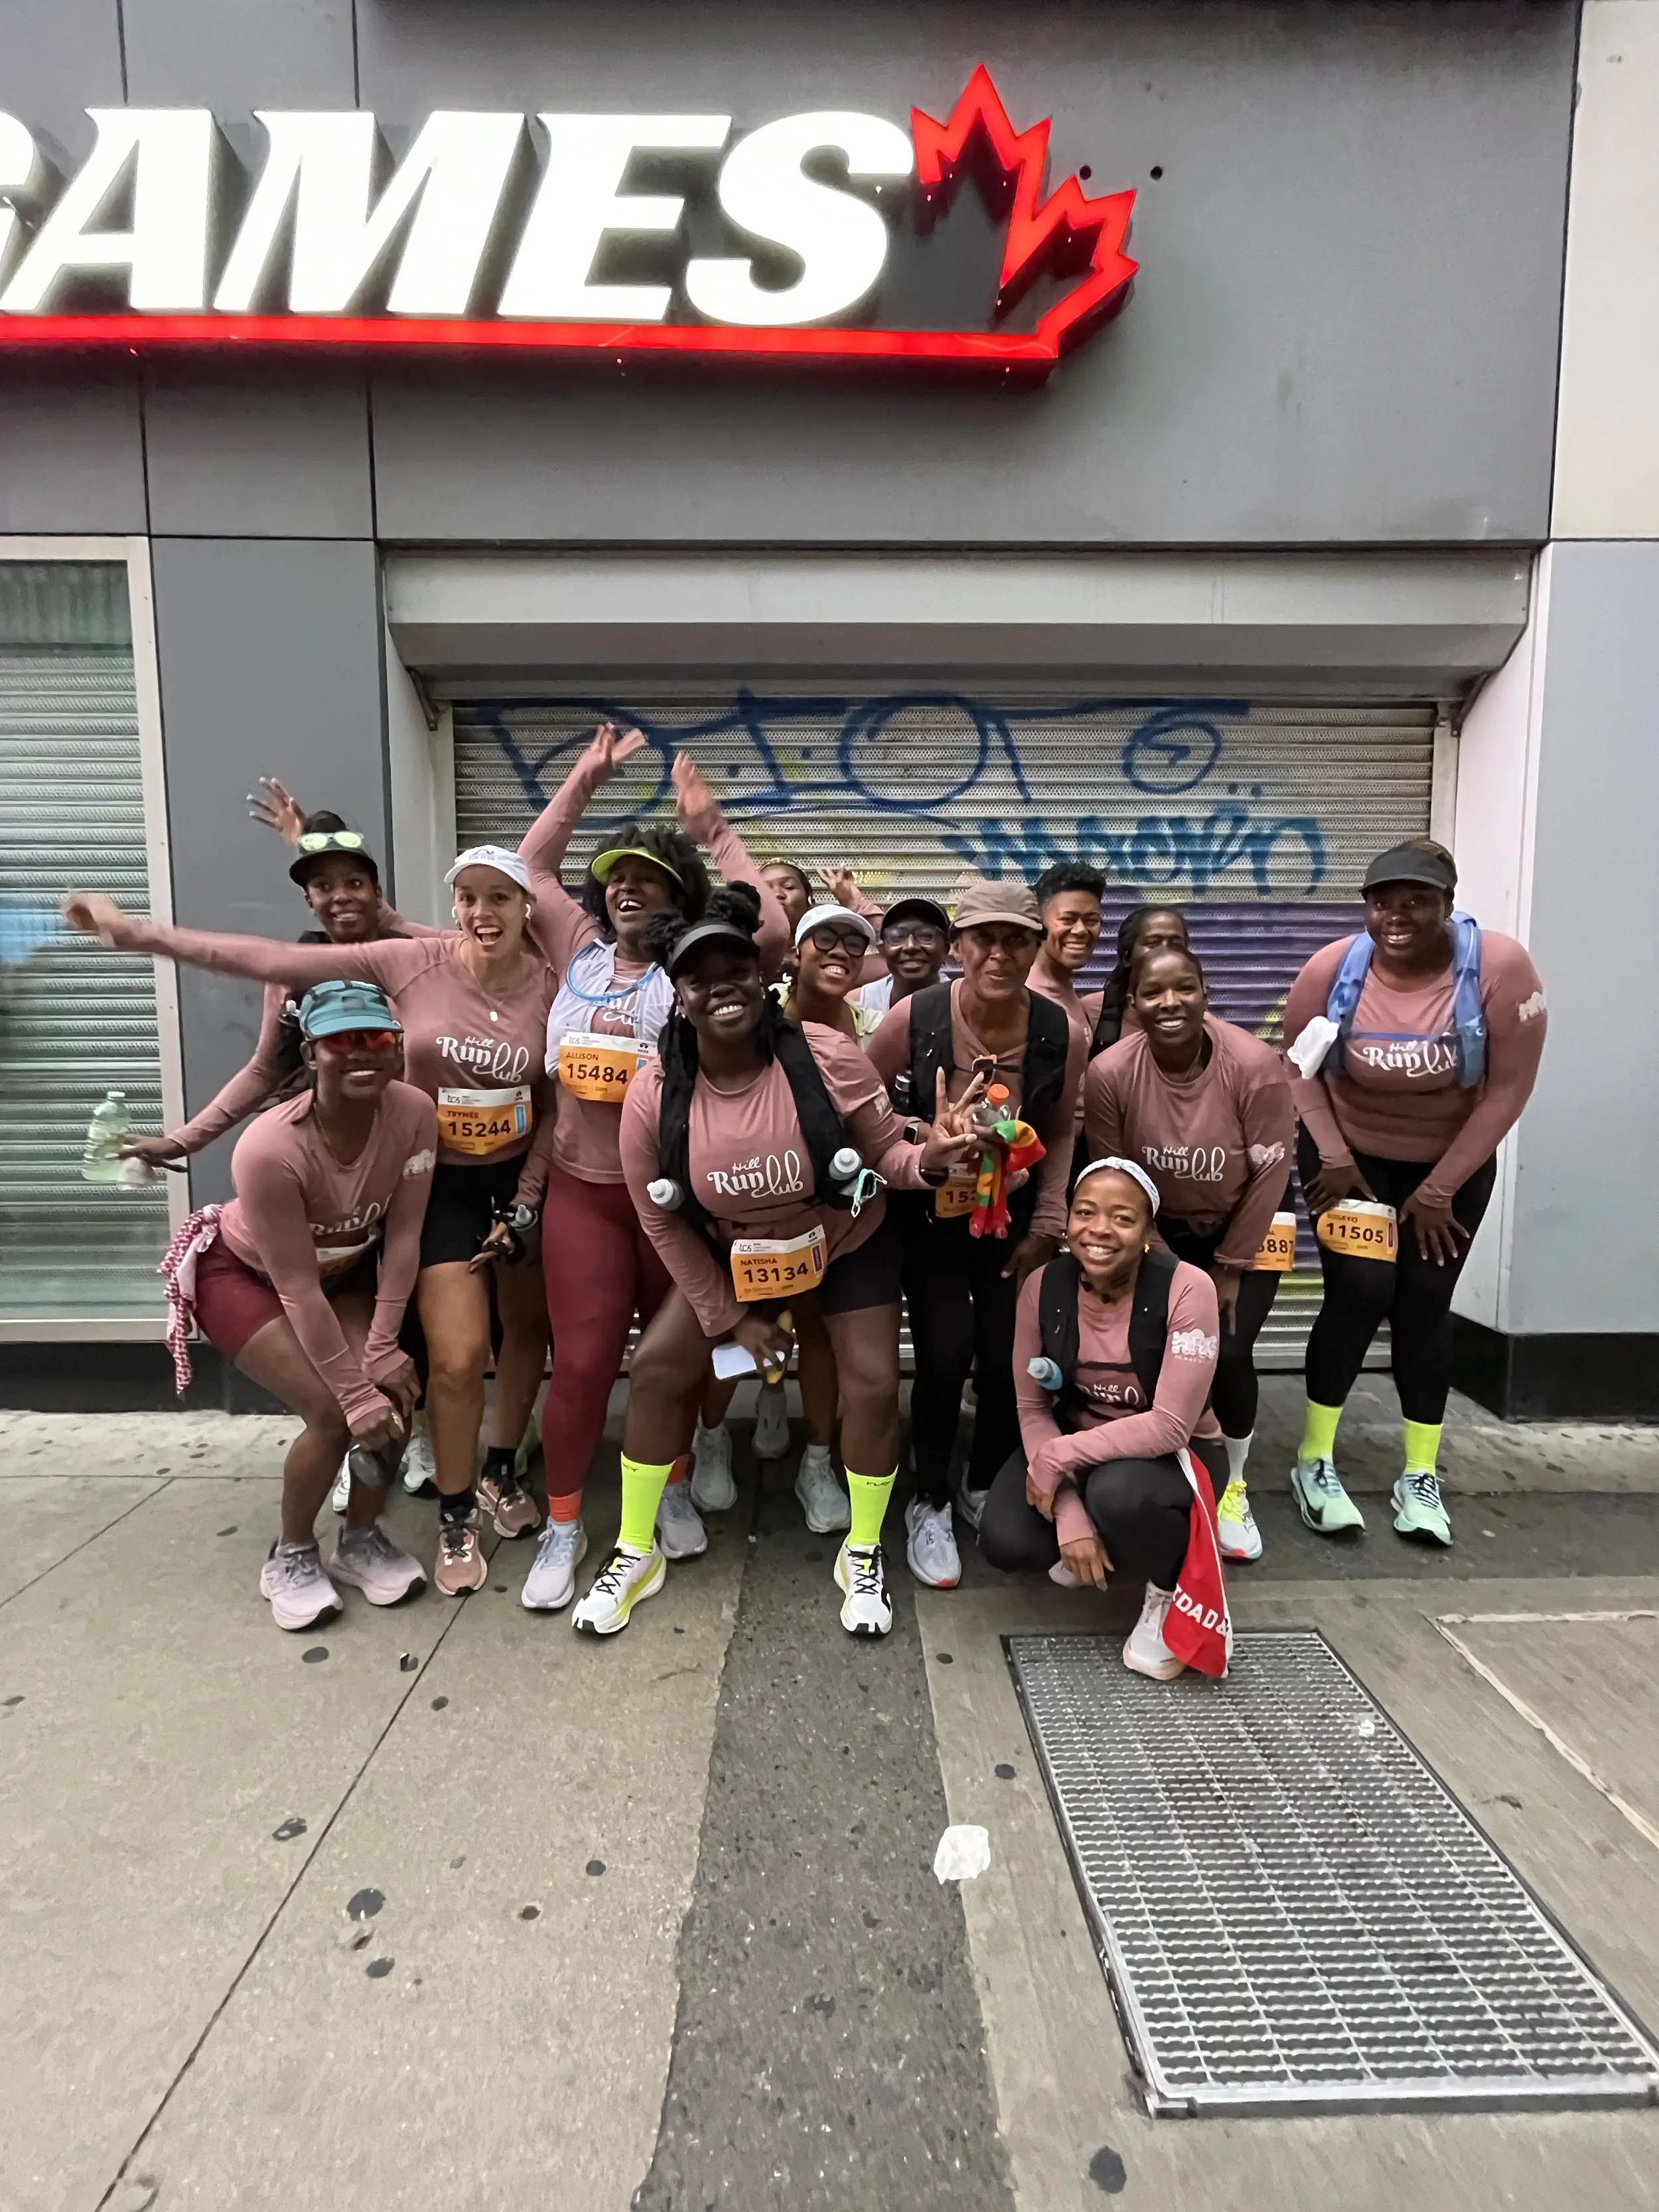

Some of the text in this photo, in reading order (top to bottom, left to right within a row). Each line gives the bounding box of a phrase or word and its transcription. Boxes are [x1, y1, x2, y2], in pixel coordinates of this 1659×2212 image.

[0, 108, 914, 326] AMES
[435, 1037, 491, 1067] Run
[465, 1035, 494, 1048] Hill
[566, 1052, 599, 1061] ALLISON
[1362, 1046, 1421, 1070] Run
[567, 1063, 628, 1085] 15484
[448, 1120, 510, 1138] 15244
[1141, 1146, 1189, 1172] Run
[1163, 1145, 1189, 1156] Hill
[732, 1156, 762, 1174] Hill
[707, 1171, 764, 1196] Run
[1327, 1222, 1384, 1244] 11505
[741, 1258, 778, 1266] NATISHA
[743, 1262, 809, 1283] 13134
